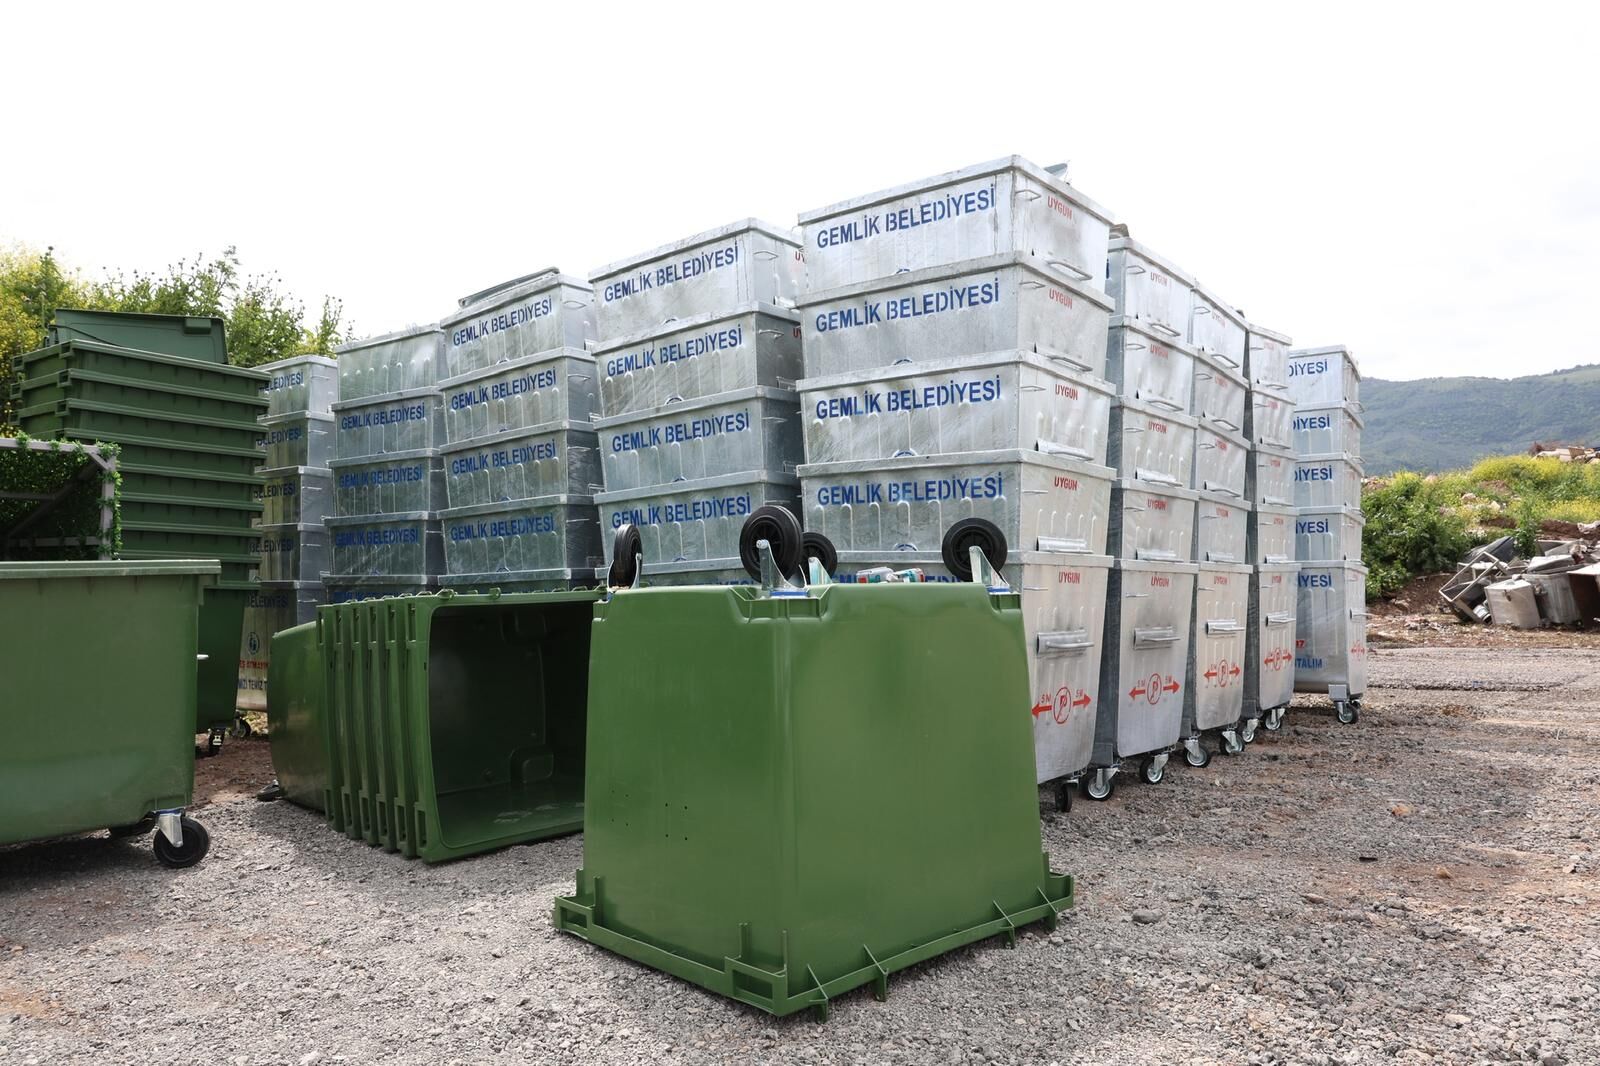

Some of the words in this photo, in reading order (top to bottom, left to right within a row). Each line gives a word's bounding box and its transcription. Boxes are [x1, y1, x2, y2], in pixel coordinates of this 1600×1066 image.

[816, 214, 881, 249] GEMLİK
[885, 183, 995, 231] BELEDİYESİ
[1047, 195, 1073, 221] UYGUN
[604, 272, 653, 303] GEMLİK
[656, 245, 739, 287] BELEDİYESİ
[815, 301, 881, 333] GEMLİK
[886, 277, 999, 321] BELEDİYESİ
[1048, 287, 1074, 310] UYGUN
[453, 319, 489, 346] GEMLİK
[491, 294, 553, 333] BELEDİYESİ
[606, 348, 657, 378] GEMLİK
[659, 323, 743, 363] BELEDİYESİ
[451, 387, 489, 411] GEMLİK
[492, 366, 557, 400] BELEDİYESİ
[816, 390, 881, 420] GEMLİK
[887, 374, 1001, 412] BELEDİYESİ
[1055, 384, 1079, 401] UYGUN
[341, 409, 371, 430] GEMLİK
[373, 402, 425, 426] BELEDİYESİ
[611, 426, 661, 453] GEMLİK
[664, 407, 750, 444] BELEDİYESİ
[1148, 421, 1168, 434] UYGUN
[452, 452, 489, 474] GEMLİK
[492, 438, 556, 466] BELEDİYESİ
[339, 471, 369, 488] GEMLİK
[370, 463, 423, 485] BELEDİYESİ
[816, 482, 882, 506] GEMLİK
[887, 471, 1002, 504] BELEDİYESİ
[1054, 476, 1079, 491] UYGUN
[612, 504, 661, 529] GEMLİK
[664, 491, 751, 523] BELEDİYESİ
[1147, 498, 1168, 510] UYGUN
[451, 520, 488, 541] GEMLİK
[490, 513, 554, 537] BELEDİYESİ
[1059, 572, 1081, 584] UYGUN
[1151, 575, 1169, 587] UYGUN
